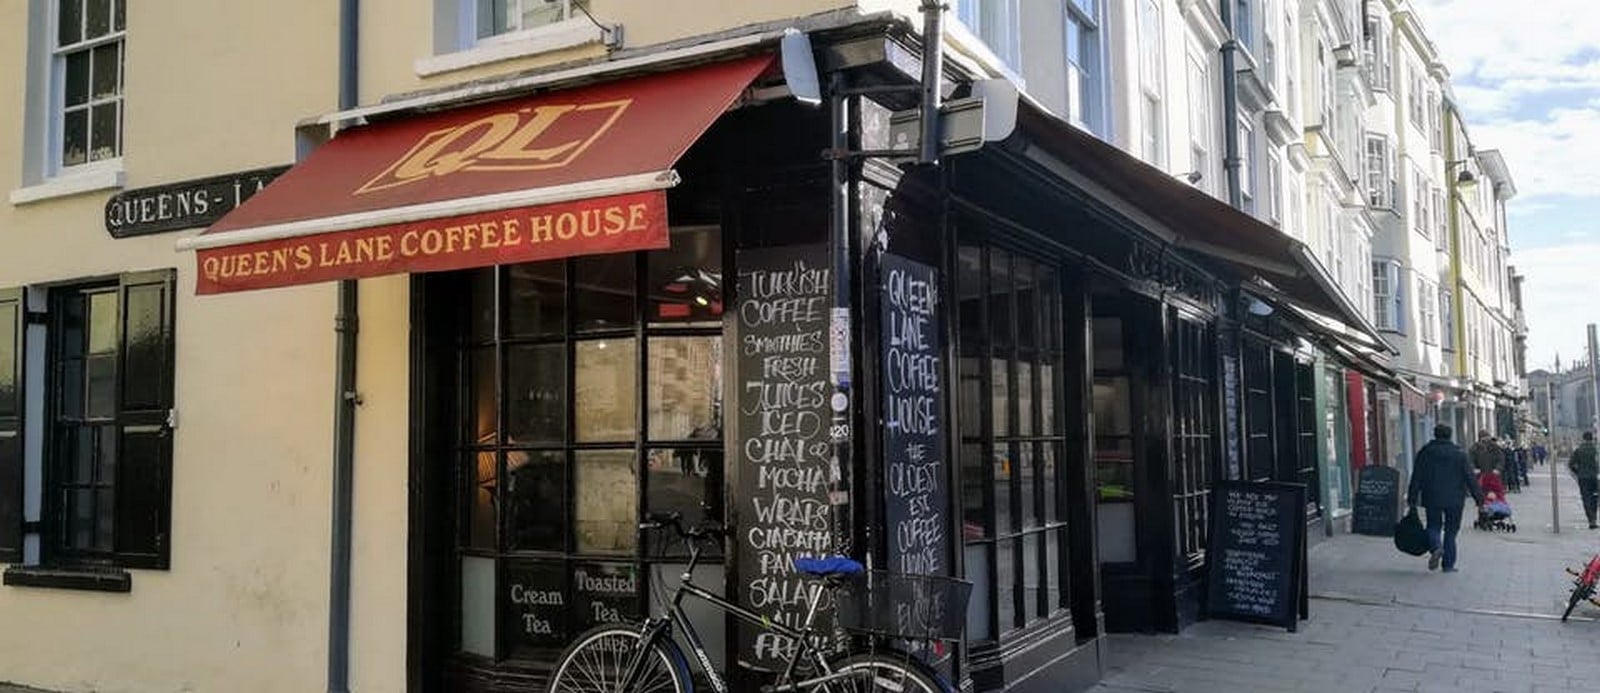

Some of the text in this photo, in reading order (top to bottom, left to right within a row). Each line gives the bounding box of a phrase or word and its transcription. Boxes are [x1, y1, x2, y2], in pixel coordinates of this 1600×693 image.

[395, 104, 581, 177] QL
[203, 204, 649, 282] QUEEN'S LANE COFFEE HOUSE
[738, 260, 829, 298] TURKISH
[741, 296, 826, 327] COFFEE
[890, 311, 930, 350] LANE
[763, 356, 820, 380] FRESH
[887, 348, 939, 393] COFFEE
[743, 380, 826, 416] JUICES
[760, 410, 821, 439] ICED
[887, 395, 938, 438] HOUSE
[745, 438, 806, 464] CHAI
[760, 465, 830, 494] MOCHA
[753, 495, 829, 531] WRAPS
[897, 512, 942, 553] COFFEE
[510, 583, 563, 605] Cream
[575, 570, 637, 593] Toasted
[522, 613, 551, 634] Tea
[591, 601, 621, 622] Tea
